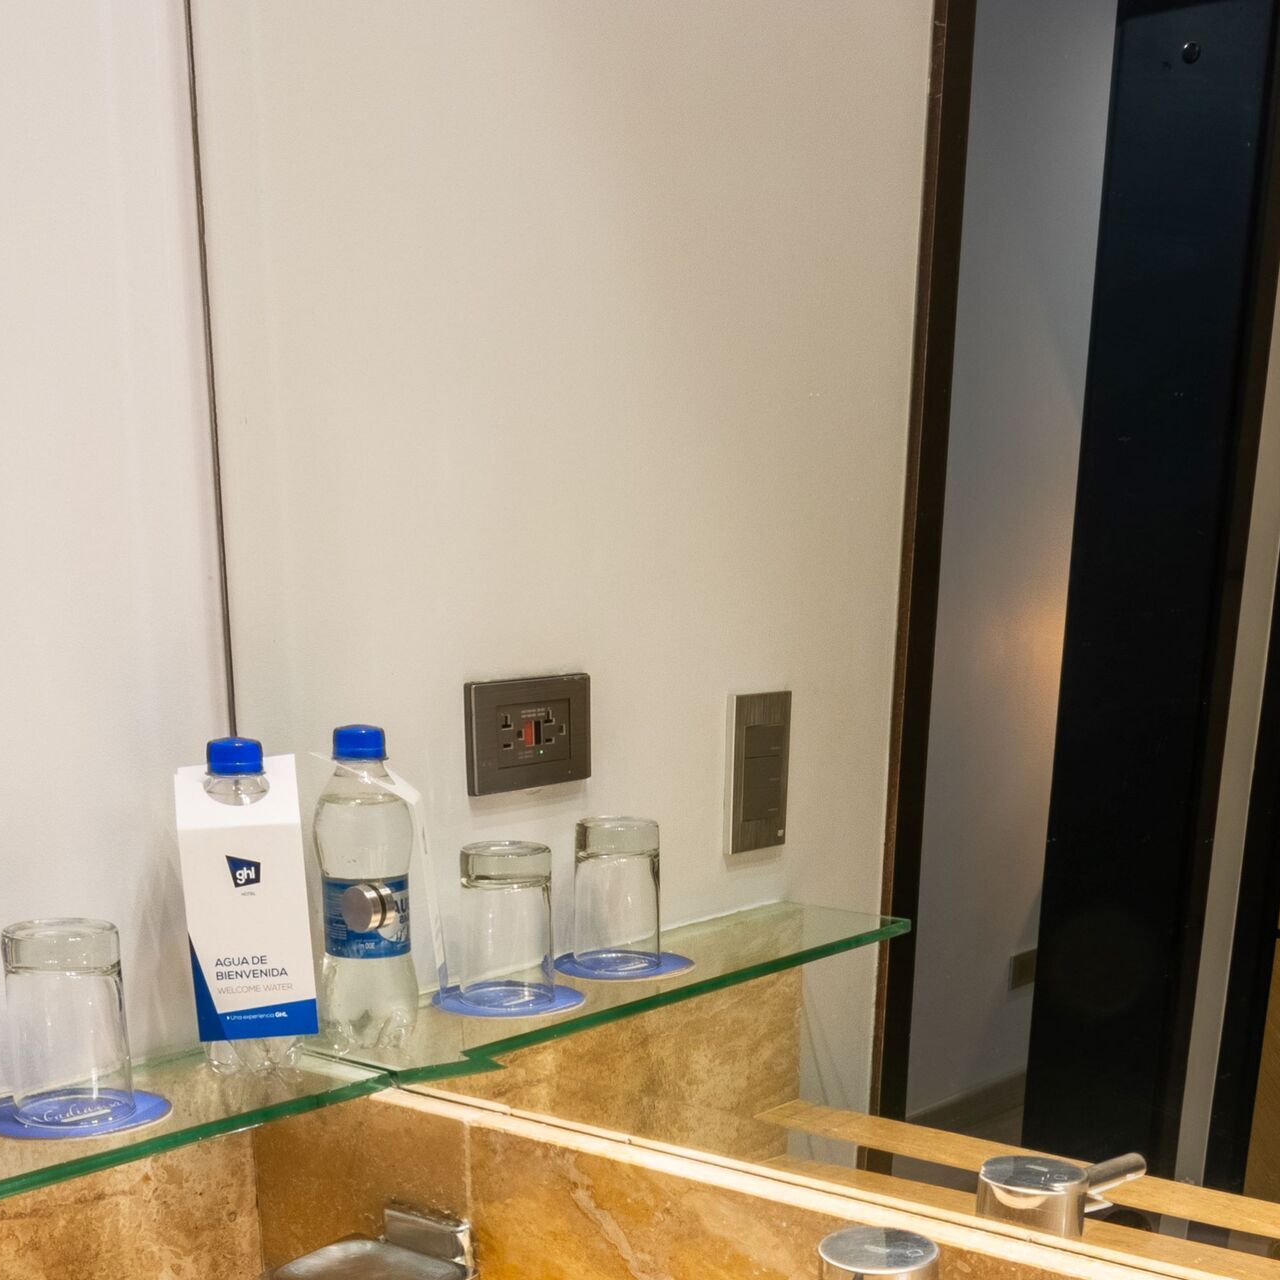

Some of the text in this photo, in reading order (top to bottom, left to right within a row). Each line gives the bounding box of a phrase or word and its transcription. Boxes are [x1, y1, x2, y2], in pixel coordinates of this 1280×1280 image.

[236, 867, 255, 884] ghl
[215, 955, 268, 967] AGUA DE
[216, 968, 288, 980] BIENVENIDA
[217, 983, 293, 994] WELCOME WATER
